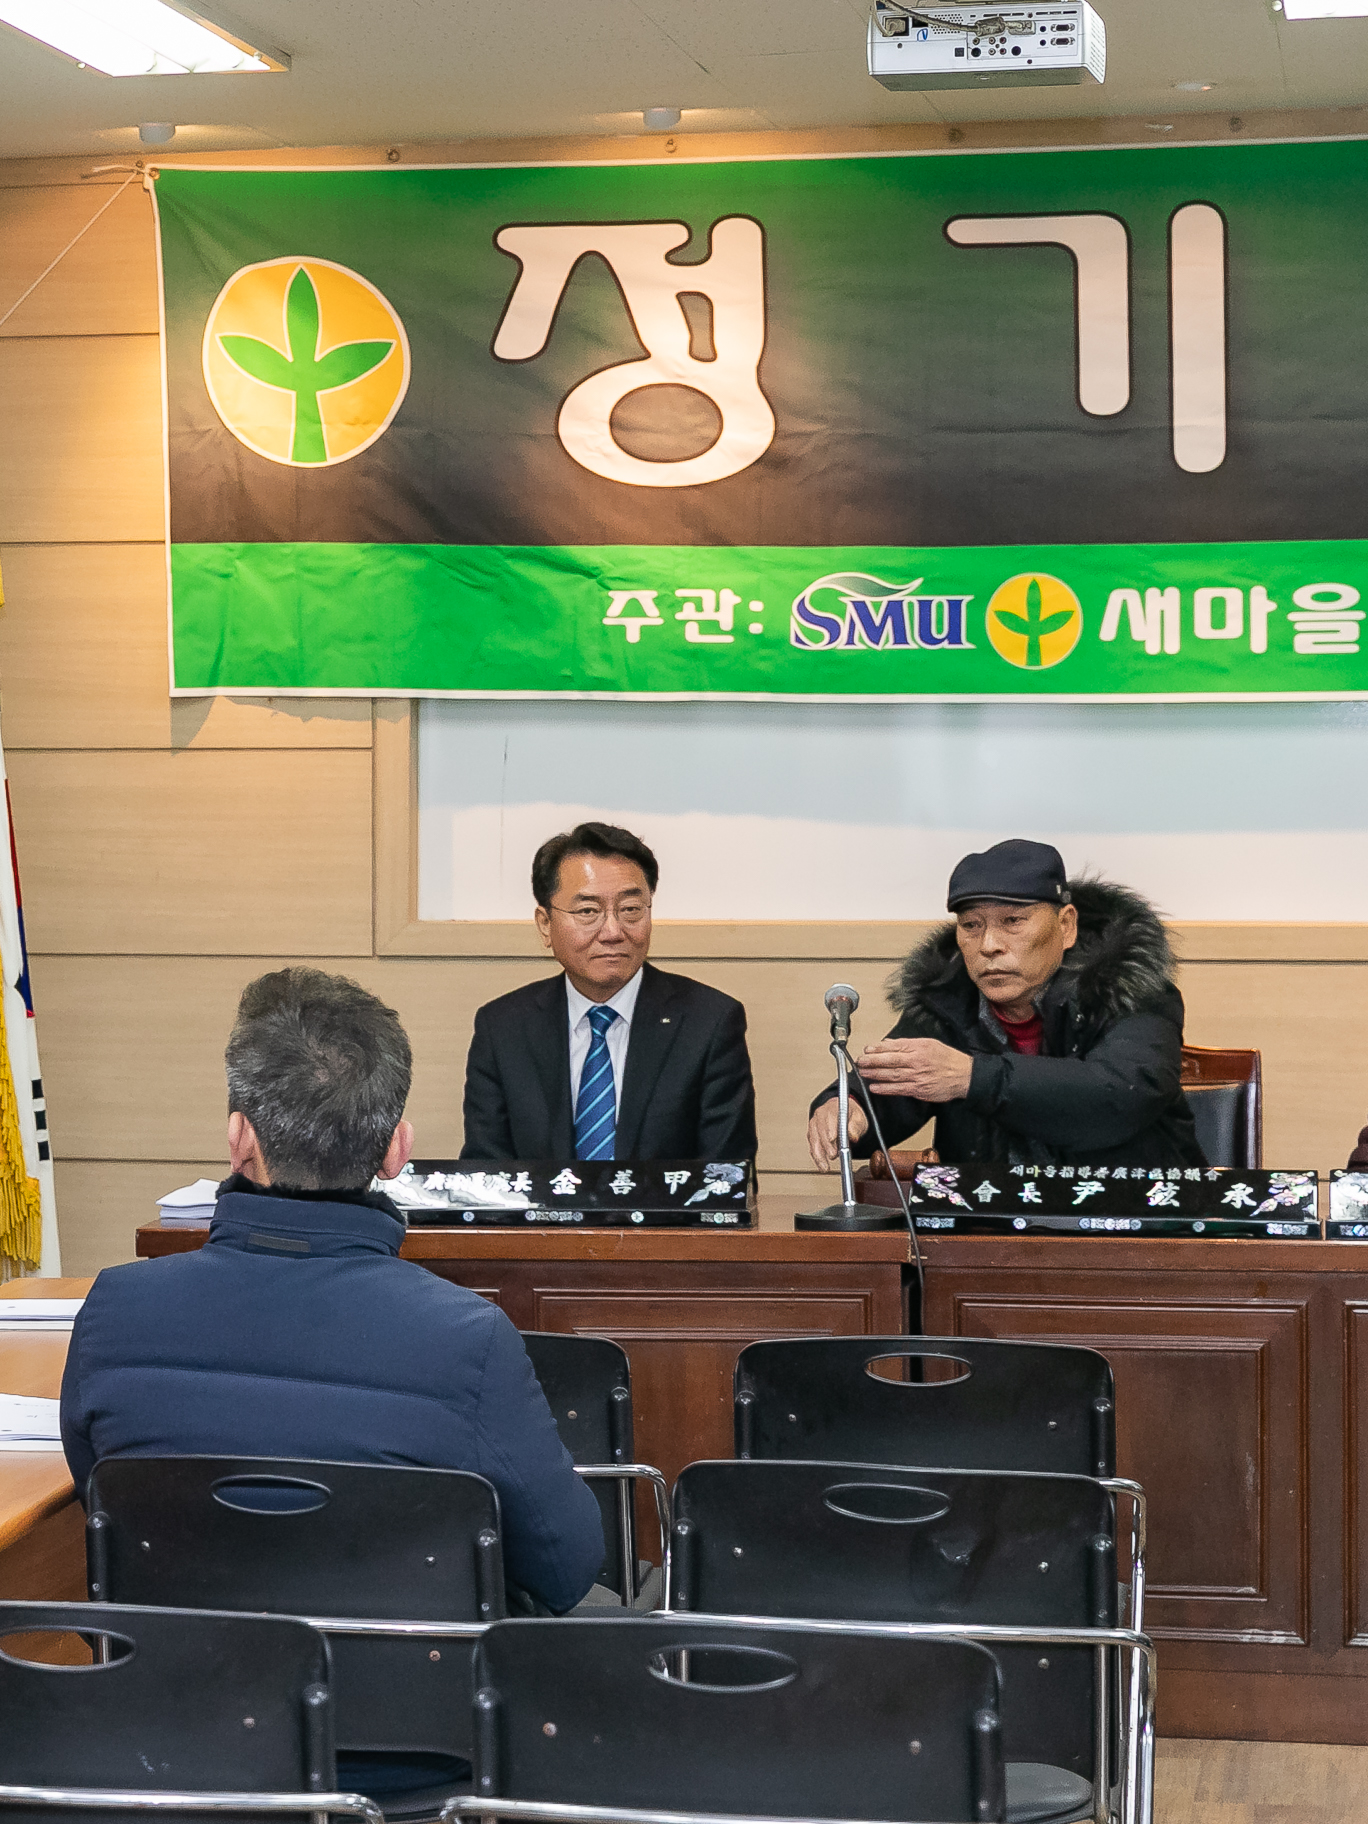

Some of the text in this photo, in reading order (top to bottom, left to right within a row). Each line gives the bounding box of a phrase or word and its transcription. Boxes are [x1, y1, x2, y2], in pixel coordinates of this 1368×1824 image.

[602, 571, 1366, 655] 주관: SMU 새마을
